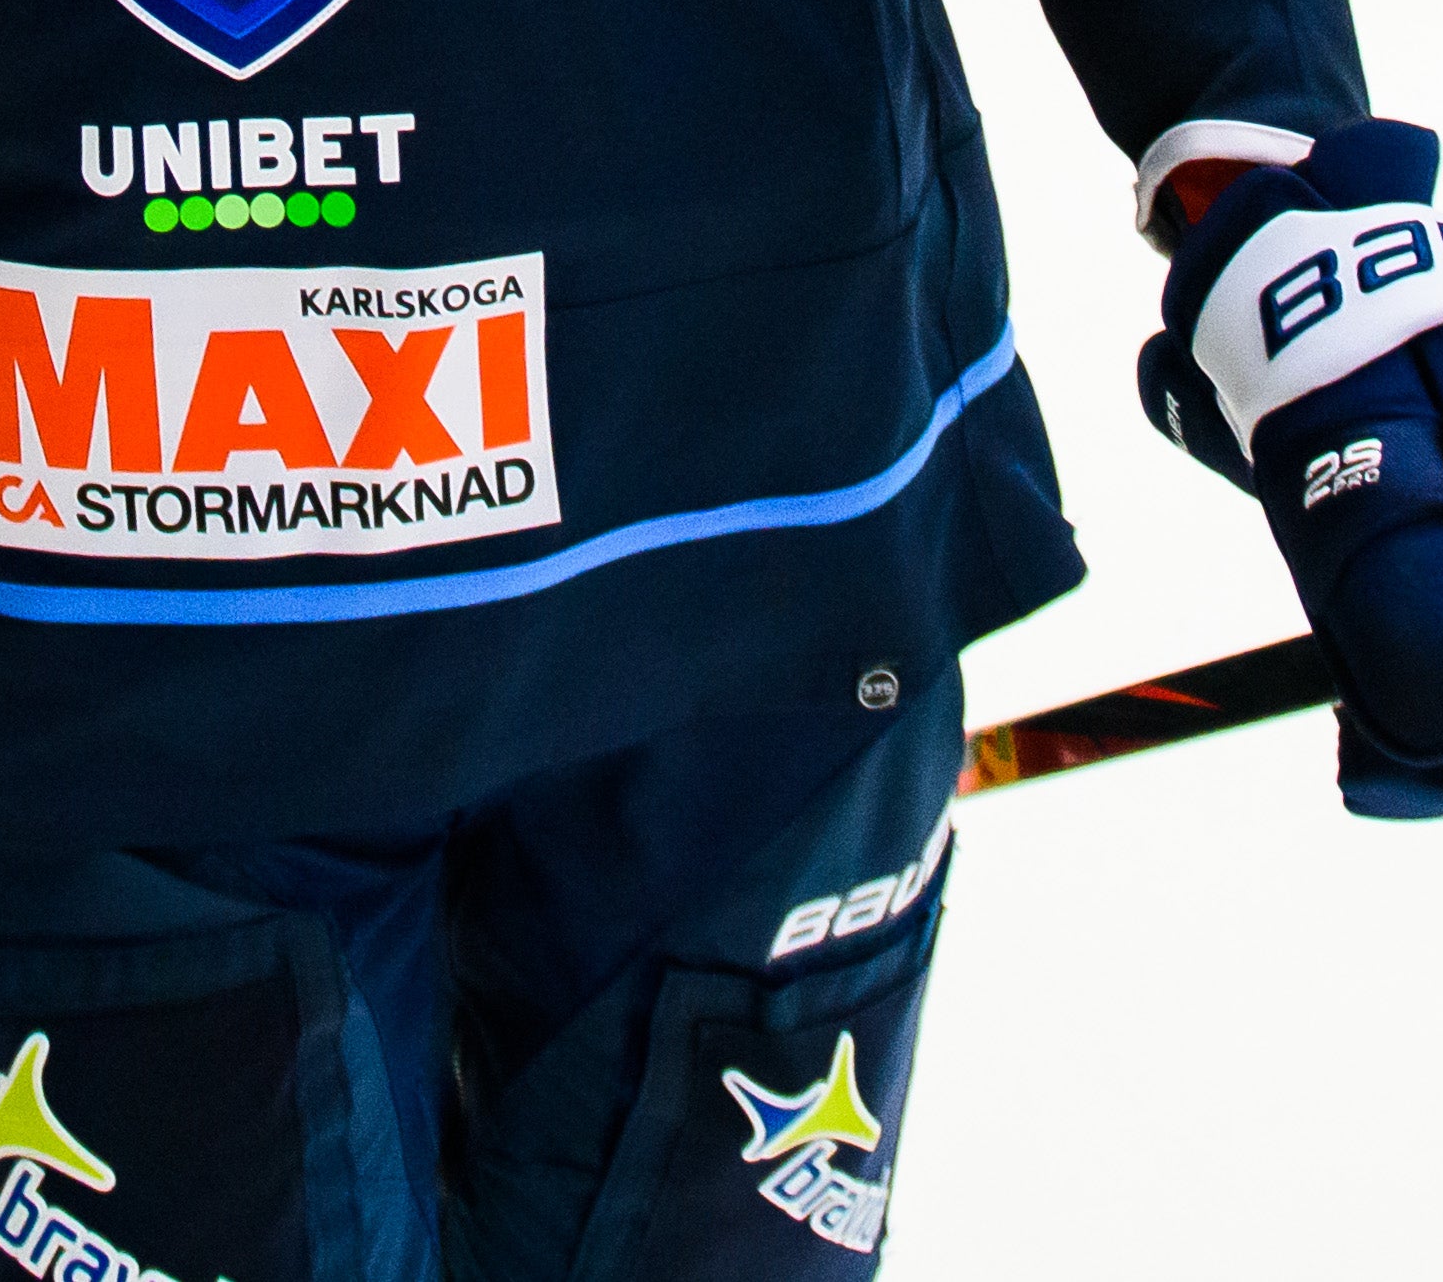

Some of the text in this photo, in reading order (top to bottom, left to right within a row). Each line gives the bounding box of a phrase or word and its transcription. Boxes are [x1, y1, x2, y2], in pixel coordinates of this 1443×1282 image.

[79, 113, 416, 198] UNIBET
[299, 274, 525, 319] KARLSKOGA
[74, 457, 536, 535] STORMARKNAD
